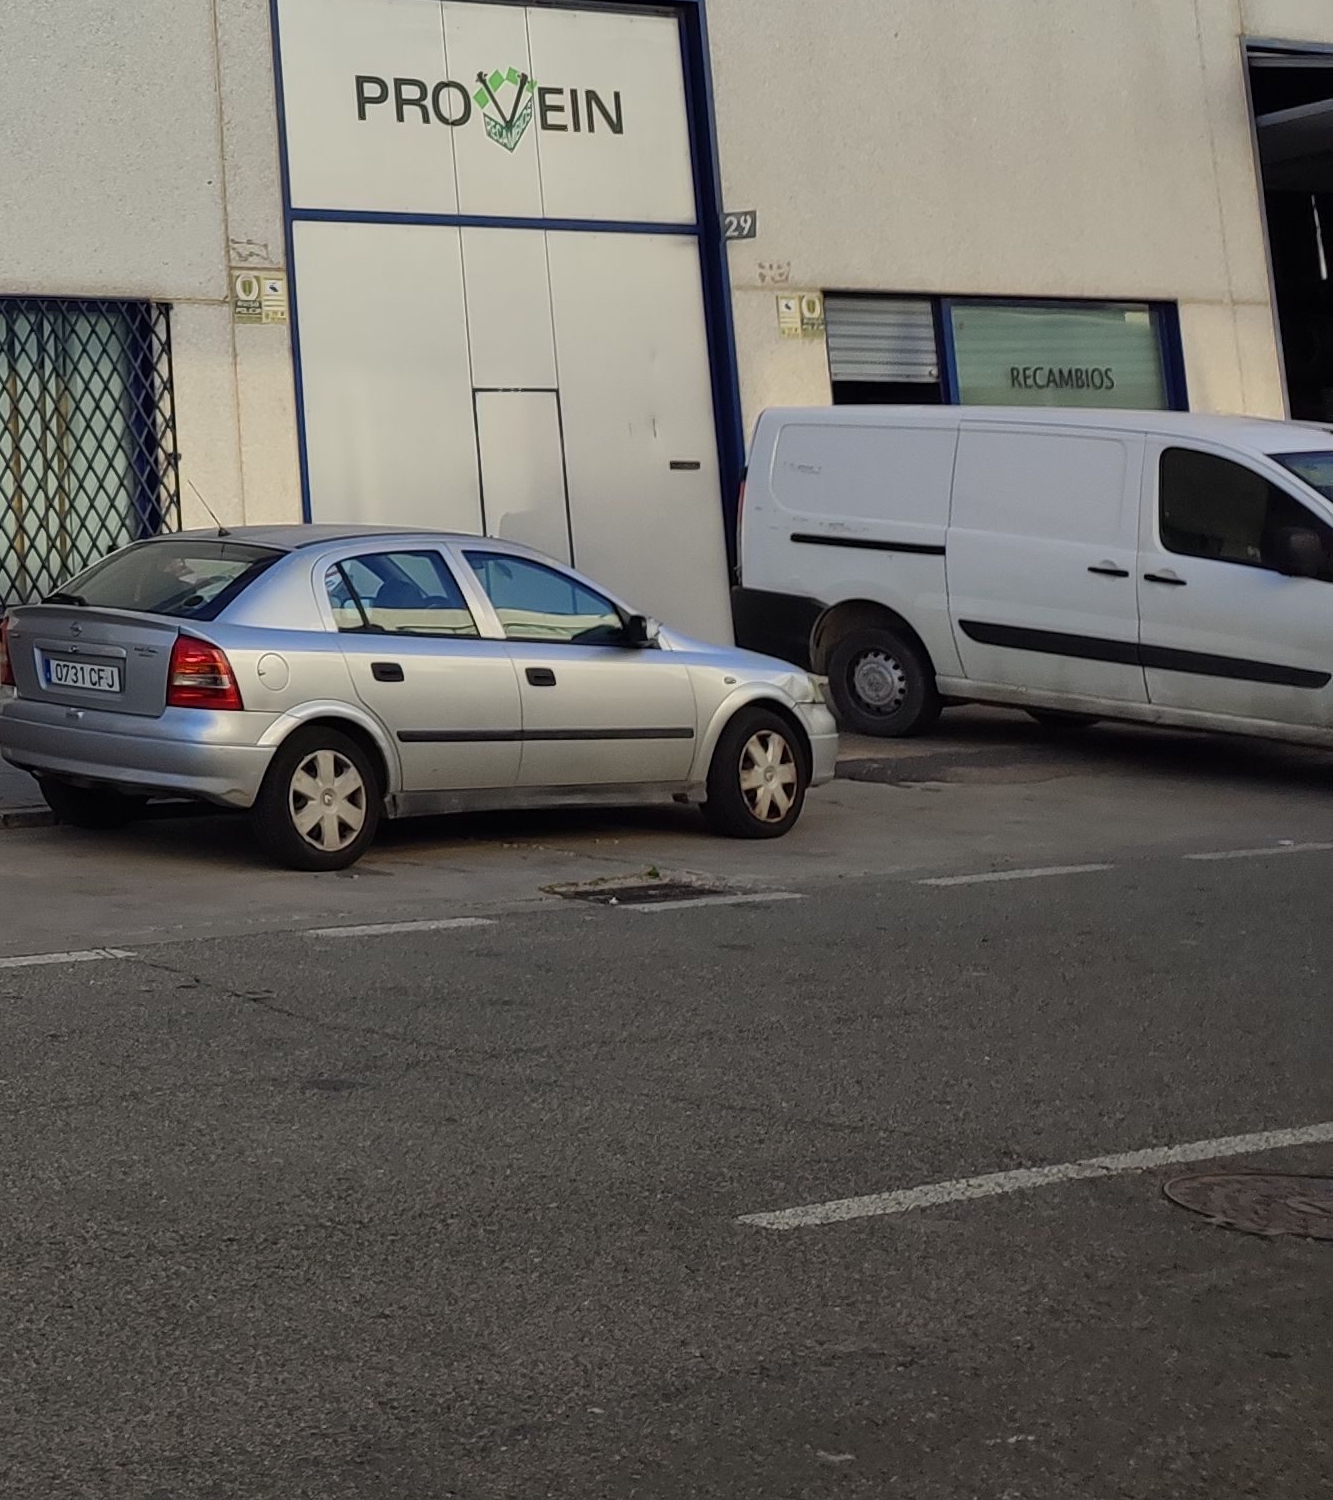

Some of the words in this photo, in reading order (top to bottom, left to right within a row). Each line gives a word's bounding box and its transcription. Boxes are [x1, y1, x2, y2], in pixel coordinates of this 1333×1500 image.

[354, 70, 624, 135] PROVEIN
[724, 214, 753, 237] 29
[1010, 366, 1115, 390] RECAMBIOS
[55, 663, 86, 685] 0731
[89, 667, 116, 689] CFJ
